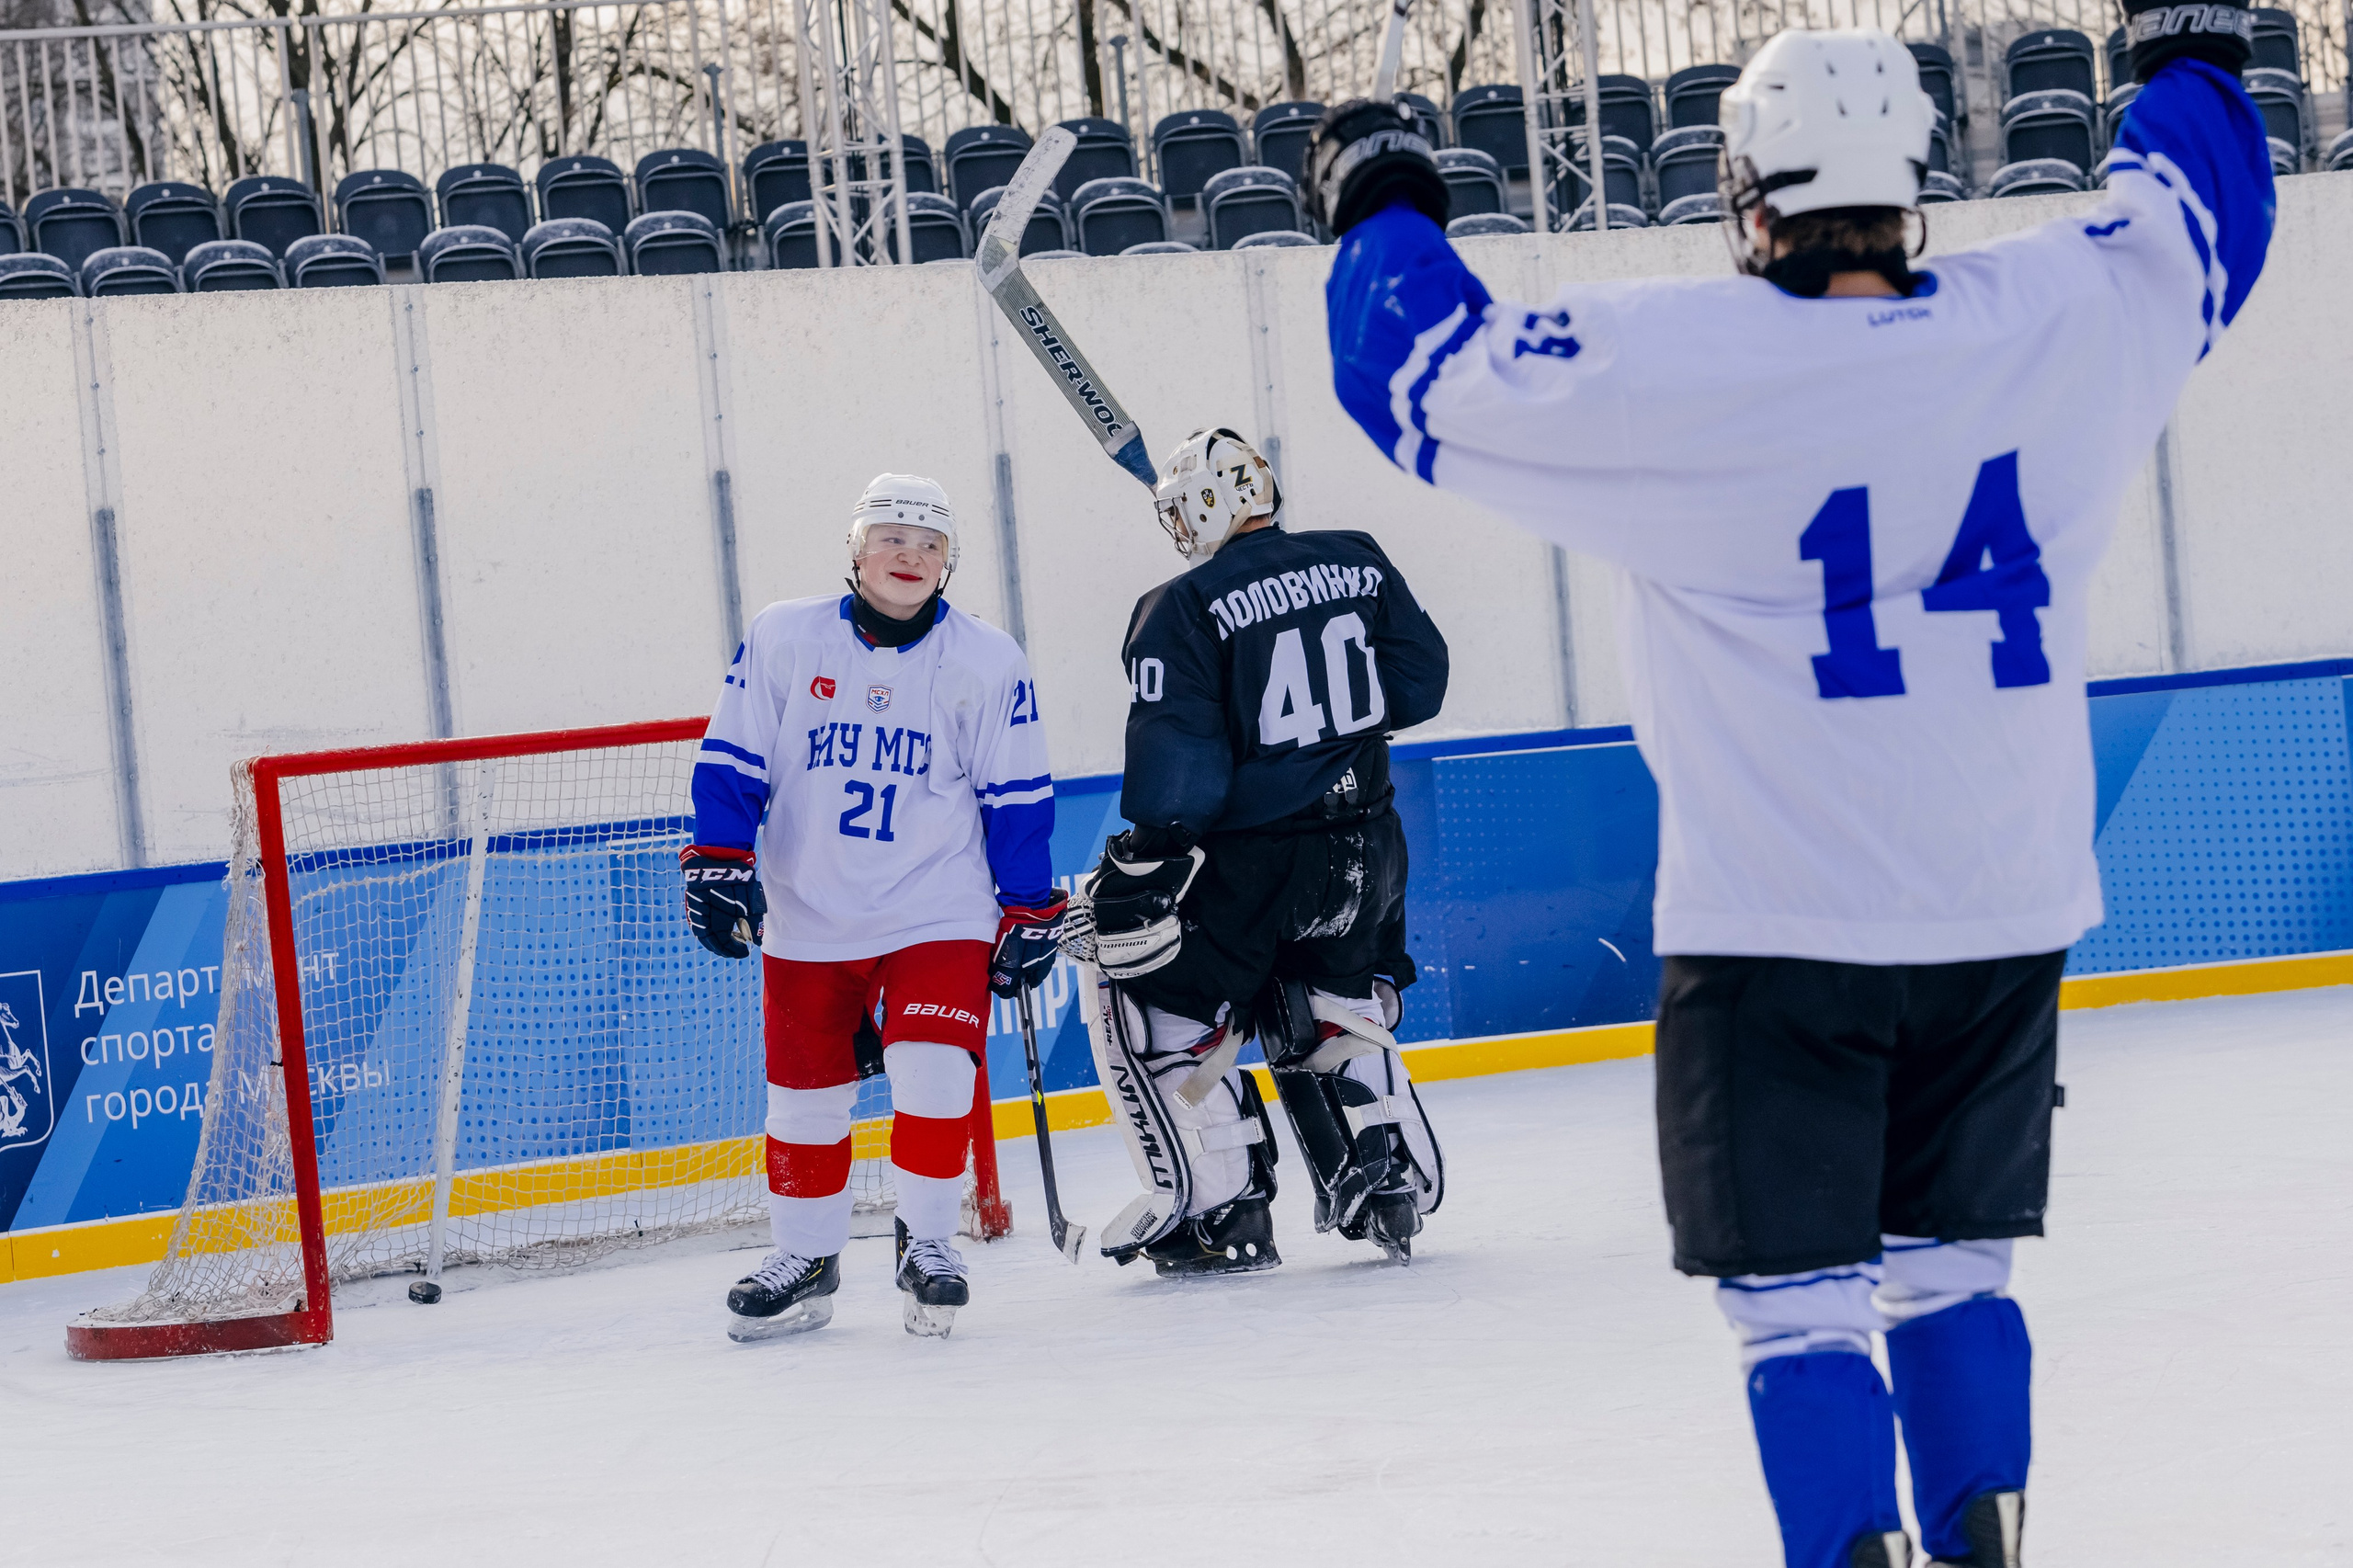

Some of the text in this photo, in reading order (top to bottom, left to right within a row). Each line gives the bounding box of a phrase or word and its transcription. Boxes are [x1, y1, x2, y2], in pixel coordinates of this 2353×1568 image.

[1230, 463, 1252, 487] Z
[1799, 448, 2051, 699] 14
[1010, 676, 1039, 728] 21
[1258, 611, 1385, 748] 40
[839, 778, 897, 842] 21
[685, 868, 754, 883] CCM
[74, 952, 340, 1018] Департмнт
[81, 1023, 218, 1069] спорта
